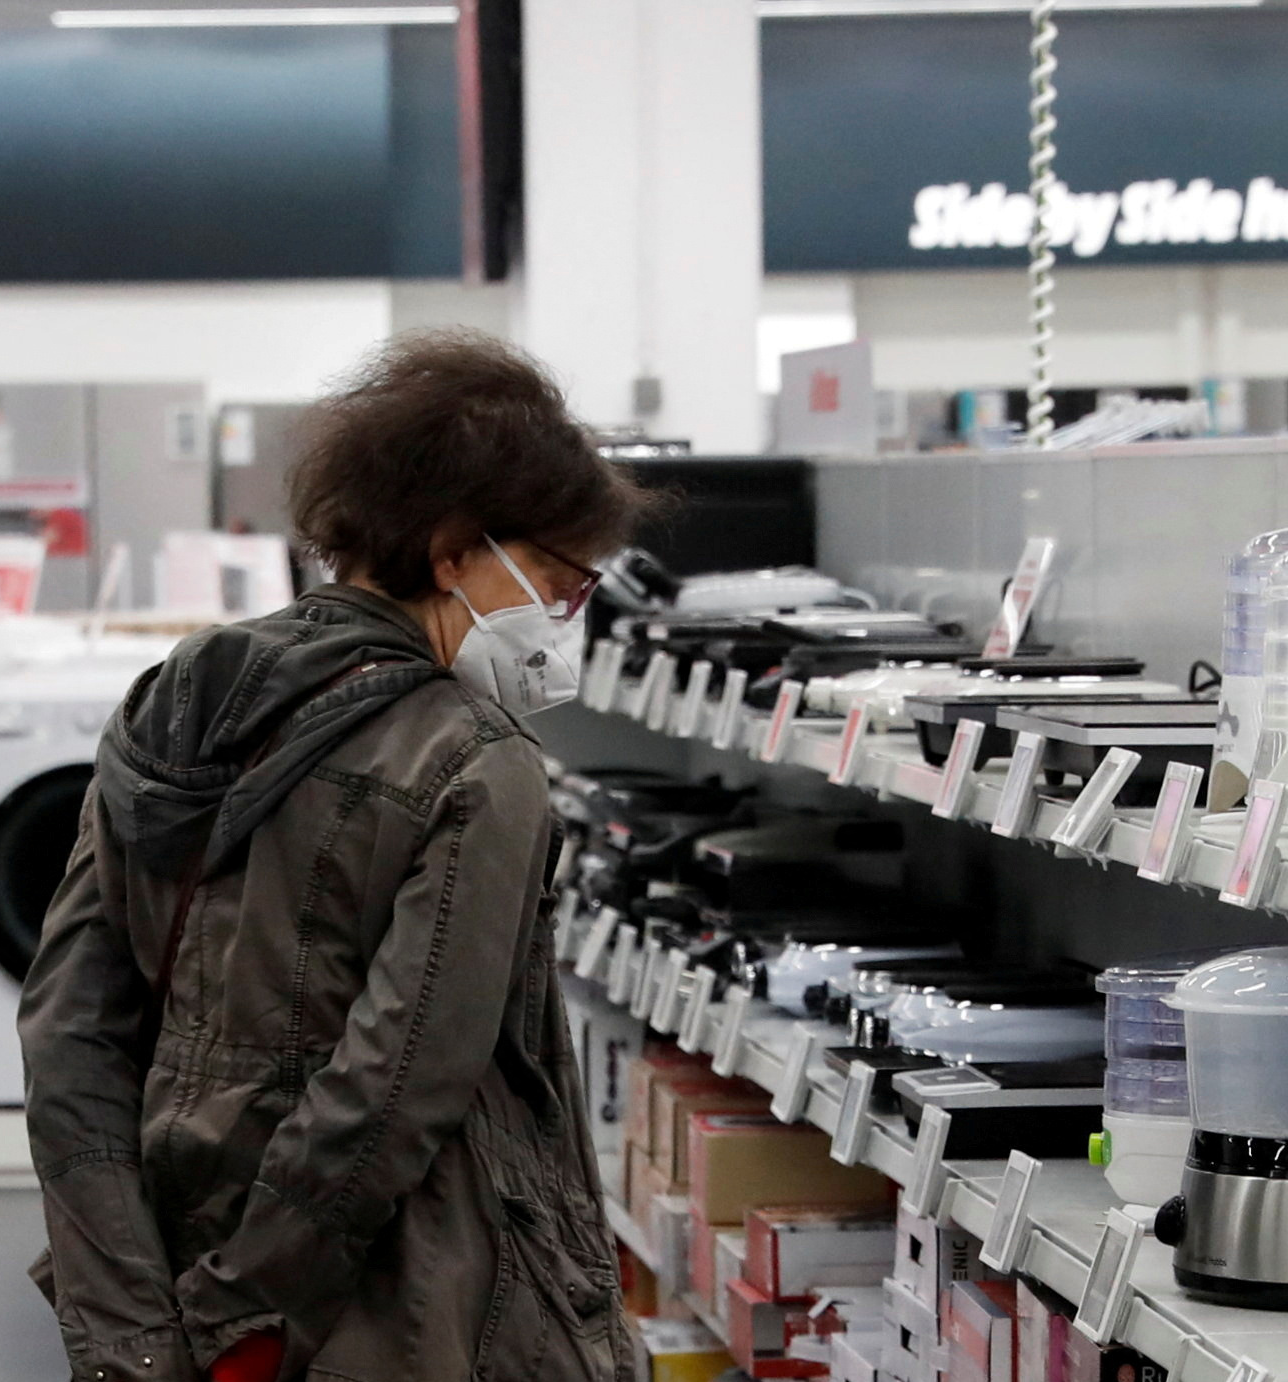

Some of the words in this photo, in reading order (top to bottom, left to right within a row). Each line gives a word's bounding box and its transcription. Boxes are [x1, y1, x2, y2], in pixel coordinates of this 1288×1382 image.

[910, 182, 1034, 249] Side
[1037, 180, 1118, 257] by
[1115, 178, 1242, 245] Side
